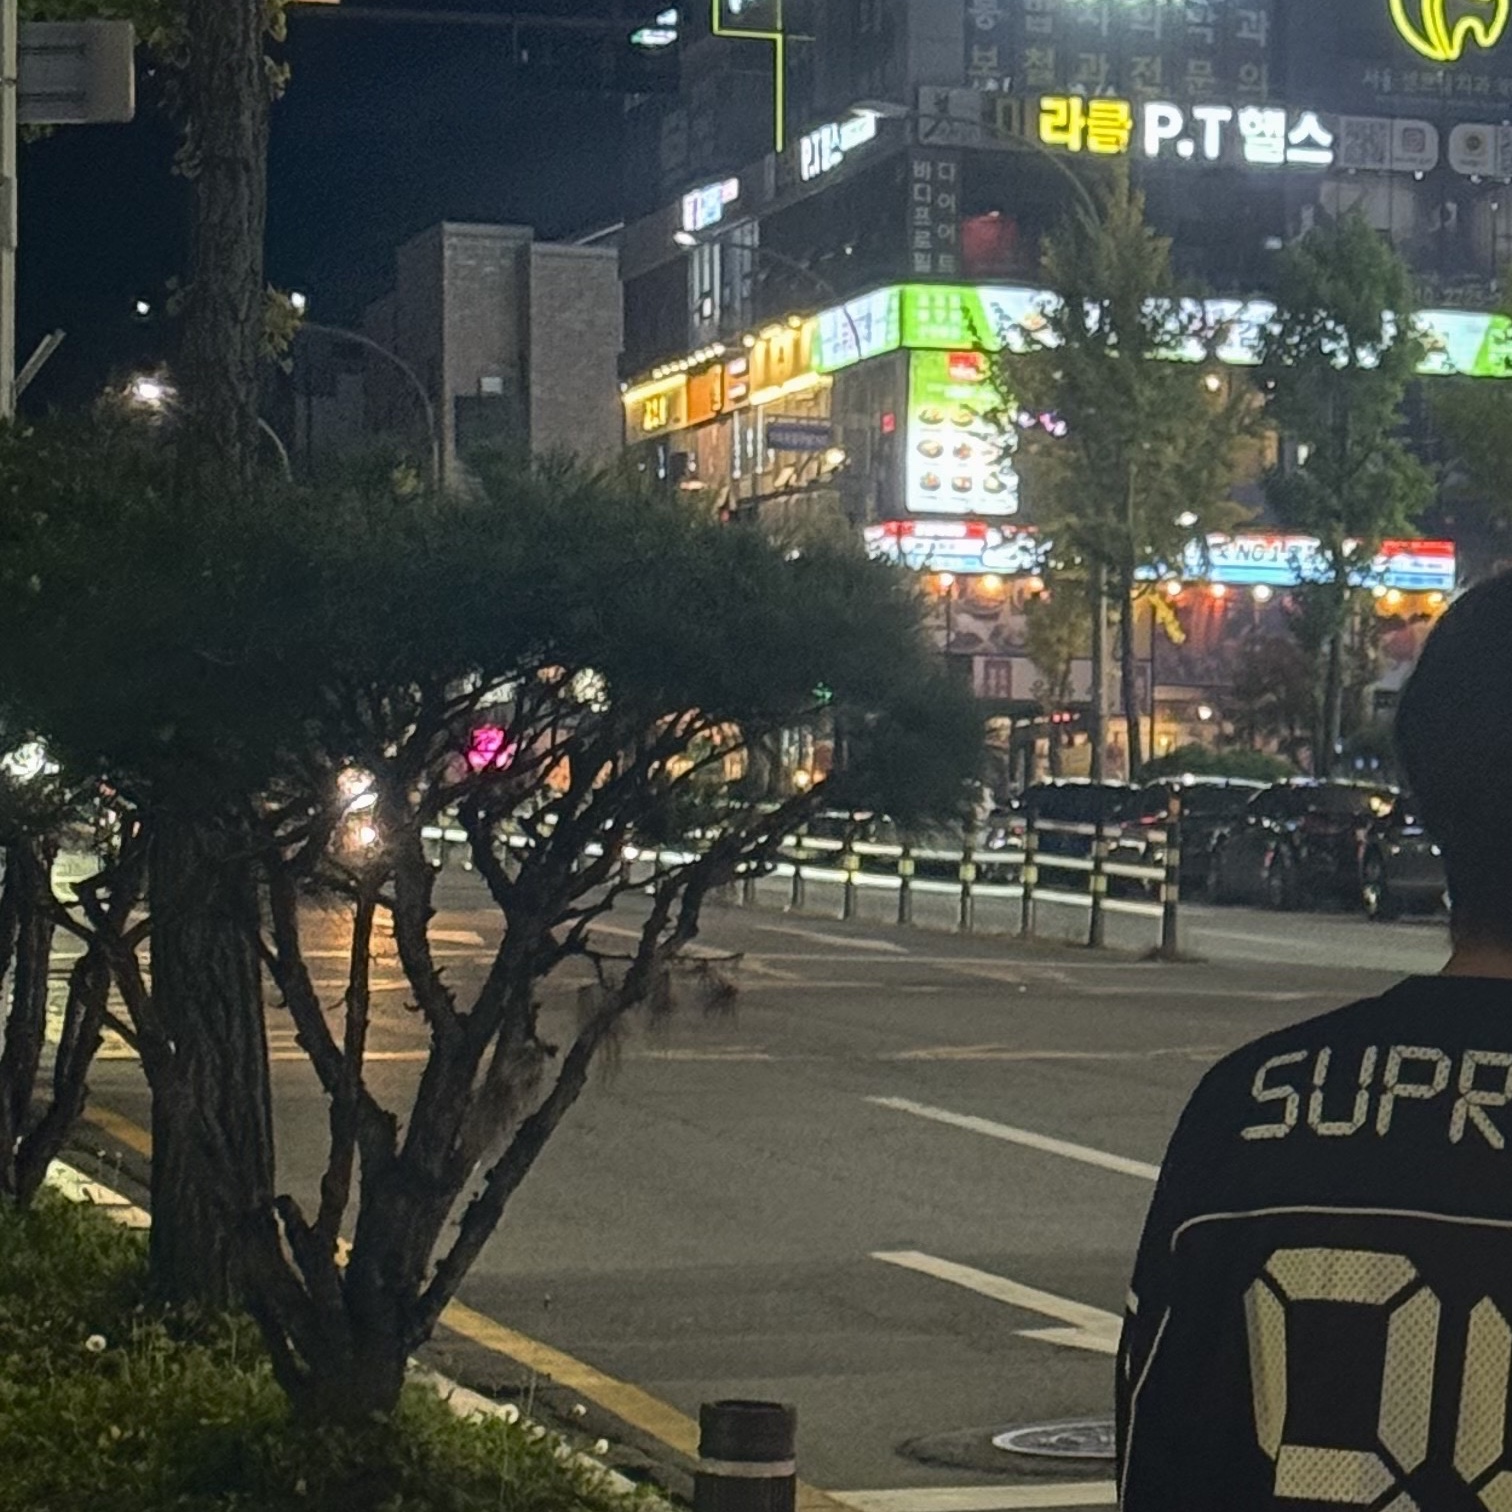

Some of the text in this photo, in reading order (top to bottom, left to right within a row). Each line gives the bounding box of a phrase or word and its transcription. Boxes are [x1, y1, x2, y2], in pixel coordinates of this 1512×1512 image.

[1143, 100, 1334, 165] P.T헬스
[912, 160, 932, 273] 바디프로필
[936, 162, 957, 273] 다이어트
